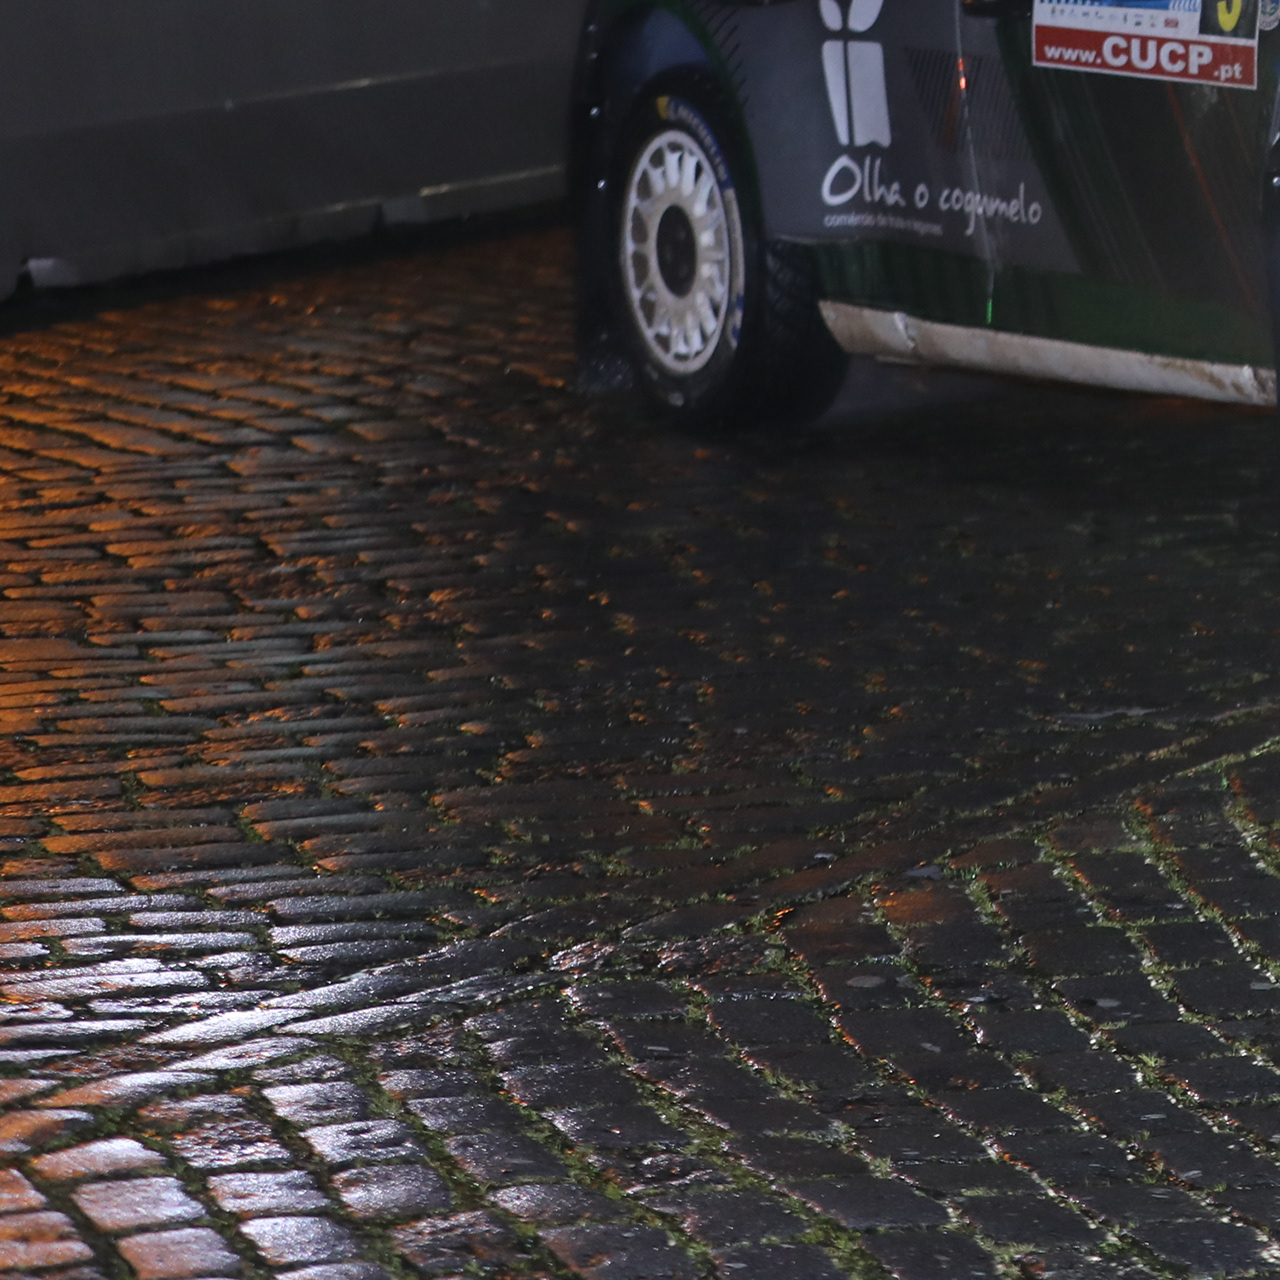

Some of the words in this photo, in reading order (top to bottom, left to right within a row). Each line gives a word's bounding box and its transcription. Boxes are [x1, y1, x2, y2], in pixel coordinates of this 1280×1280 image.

[1044, 35, 1243, 81] www.CUCP.pt
[822, 154, 906, 207] Olha
[914, 183, 929, 209] o
[938, 181, 1043, 237] cogumelo
